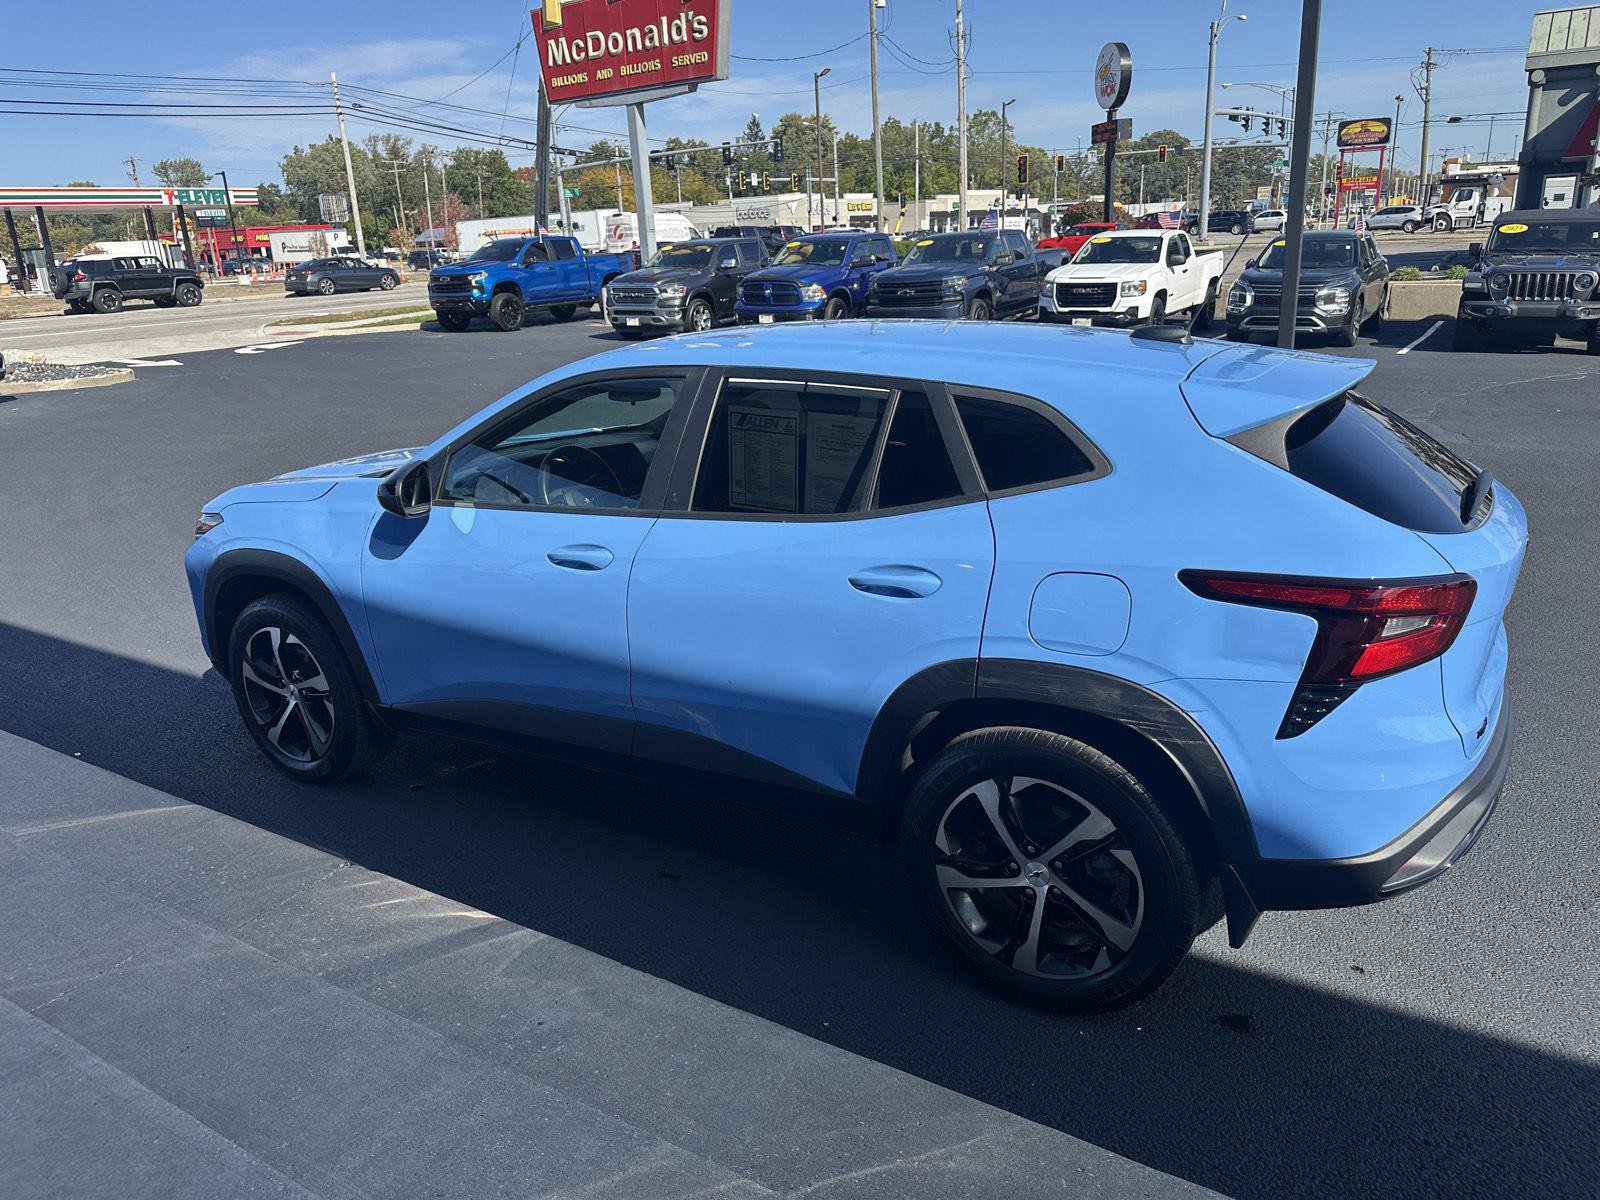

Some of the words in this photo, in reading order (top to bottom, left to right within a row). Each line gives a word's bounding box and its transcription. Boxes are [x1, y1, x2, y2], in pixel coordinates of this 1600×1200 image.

[547, 11, 709, 68] McDonald's
[551, 72, 589, 88] BILLIONS
[595, 68, 613, 81] AND
[620, 59, 661, 76] BILLIONS
[671, 51, 709, 67] SERVED
[746, 415, 779, 429] ALLEN
